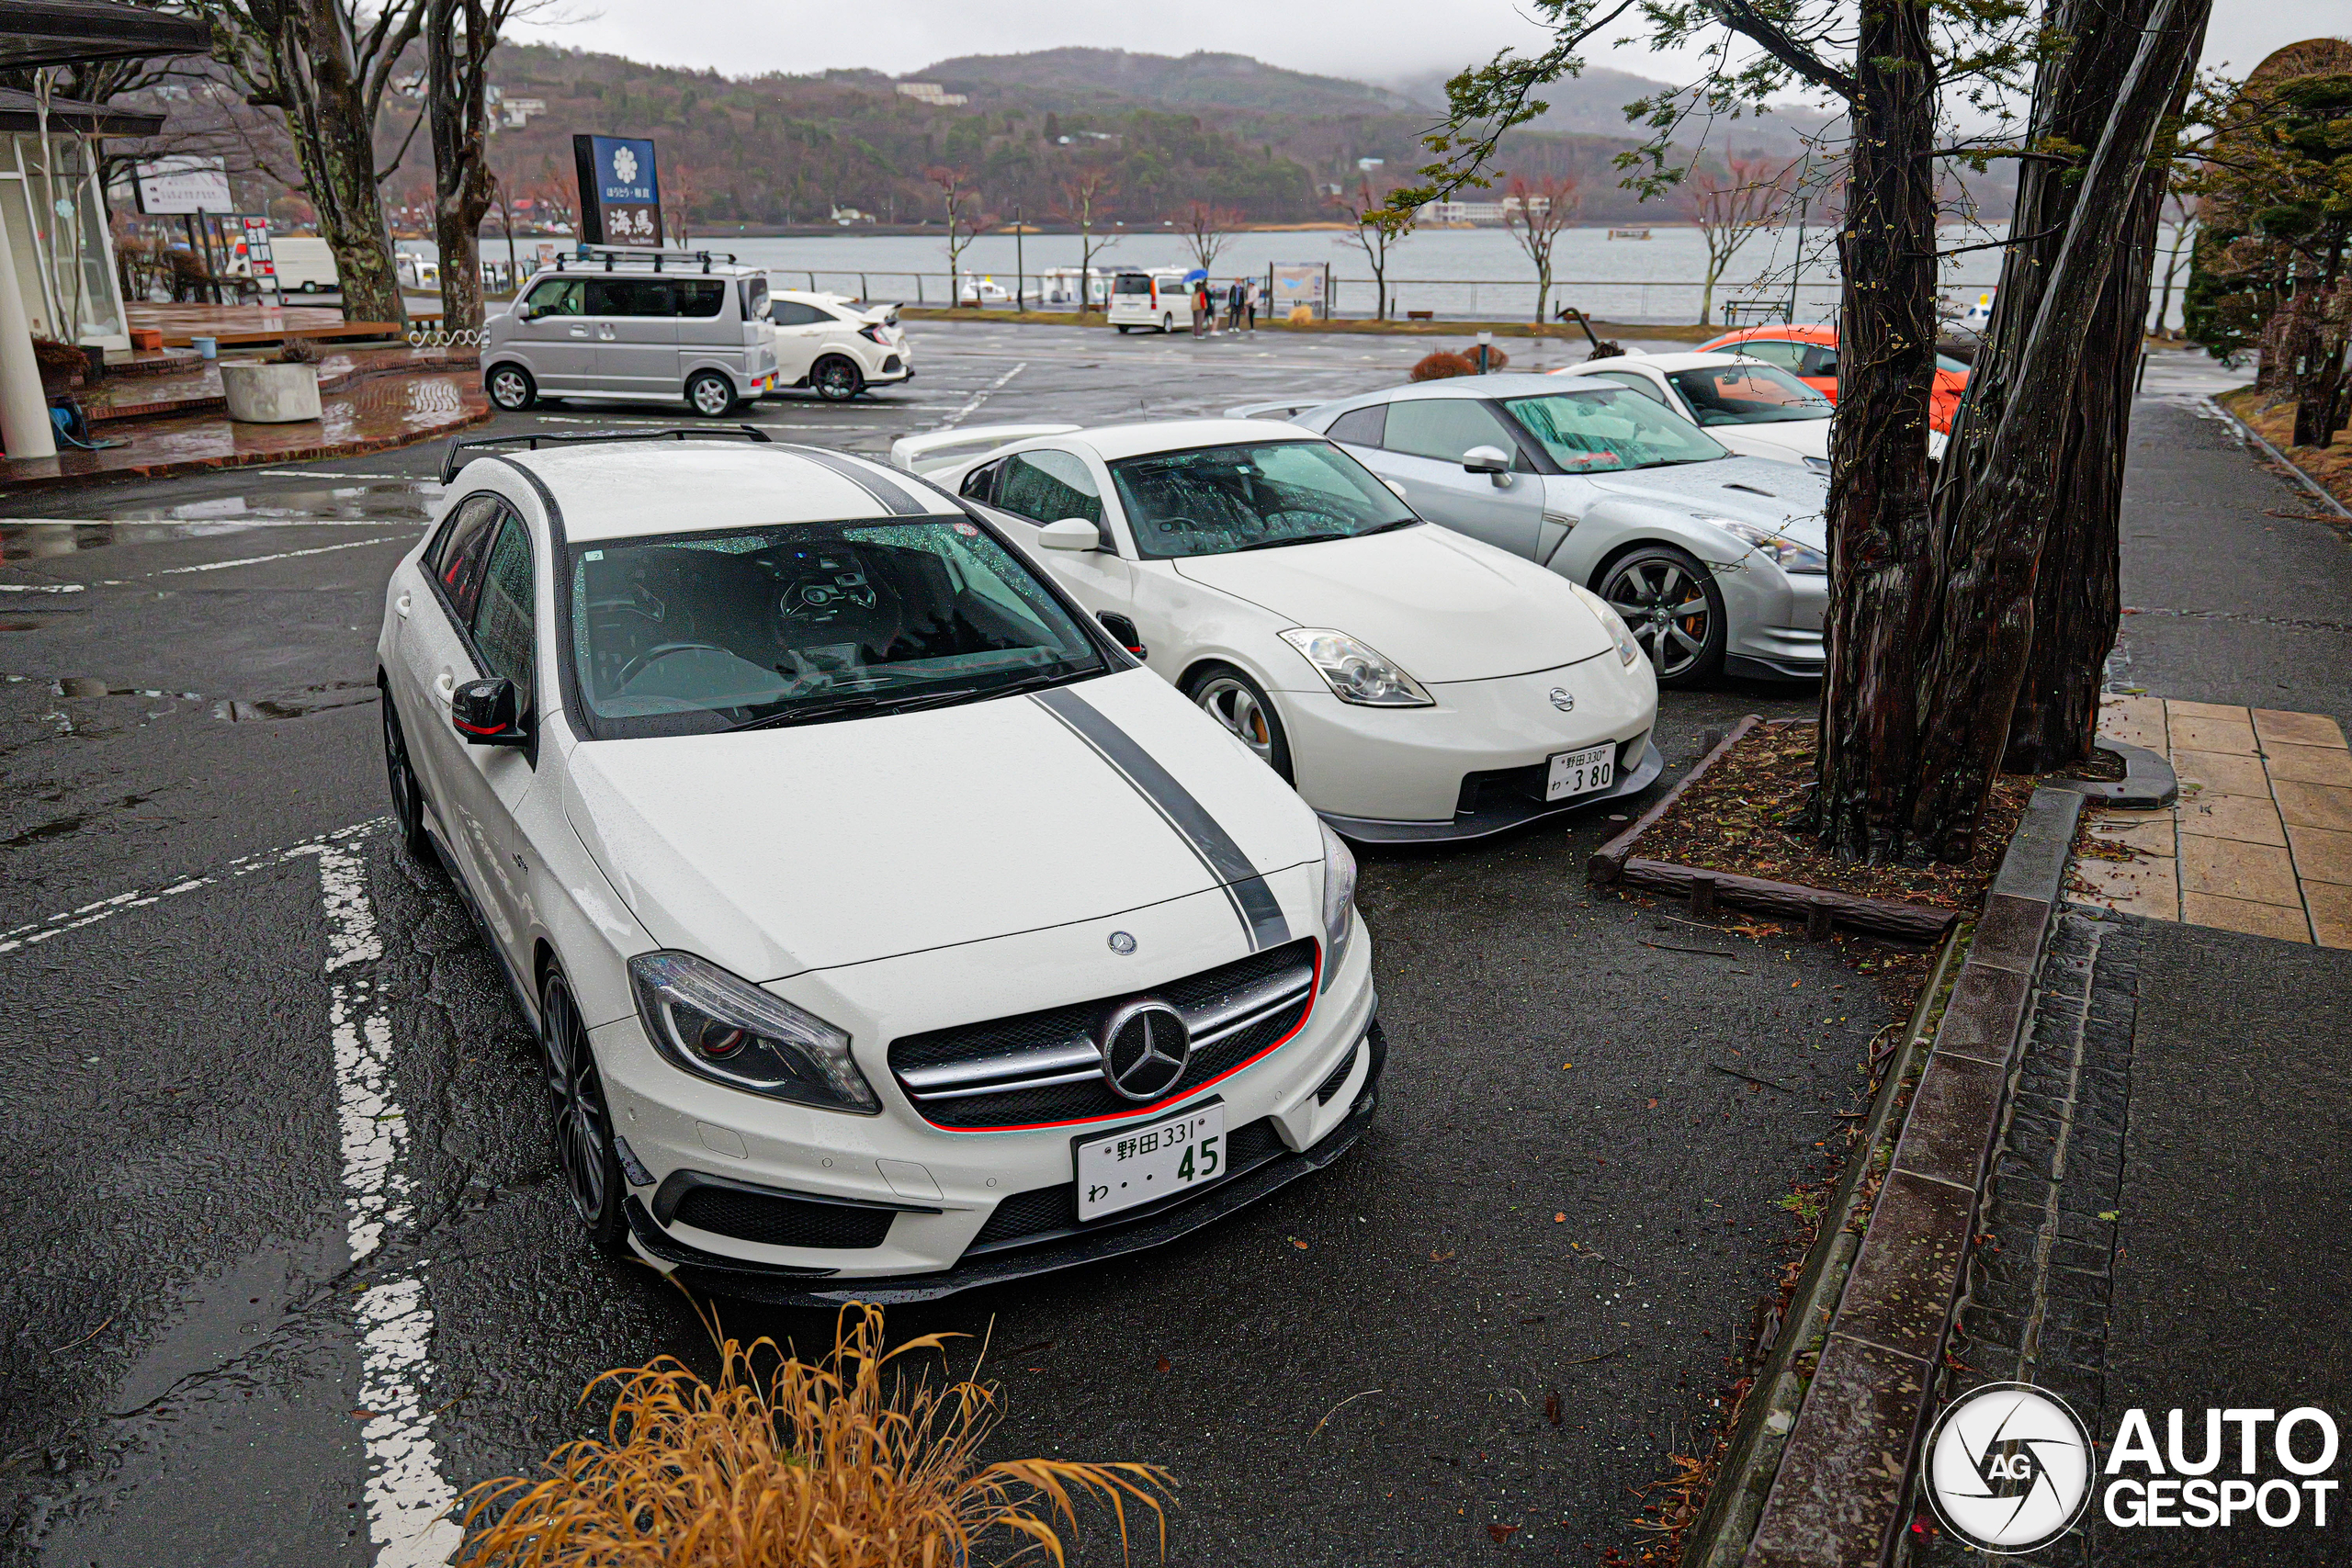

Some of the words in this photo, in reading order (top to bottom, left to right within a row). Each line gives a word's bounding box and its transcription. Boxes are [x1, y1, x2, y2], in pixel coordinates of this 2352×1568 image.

[608, 209, 653, 235] 海馬
[1566, 754, 1585, 769] 野田
[1586, 750, 1602, 764] 330
[1117, 1132, 1159, 1162] 野田
[1162, 1120, 1193, 1147] 331
